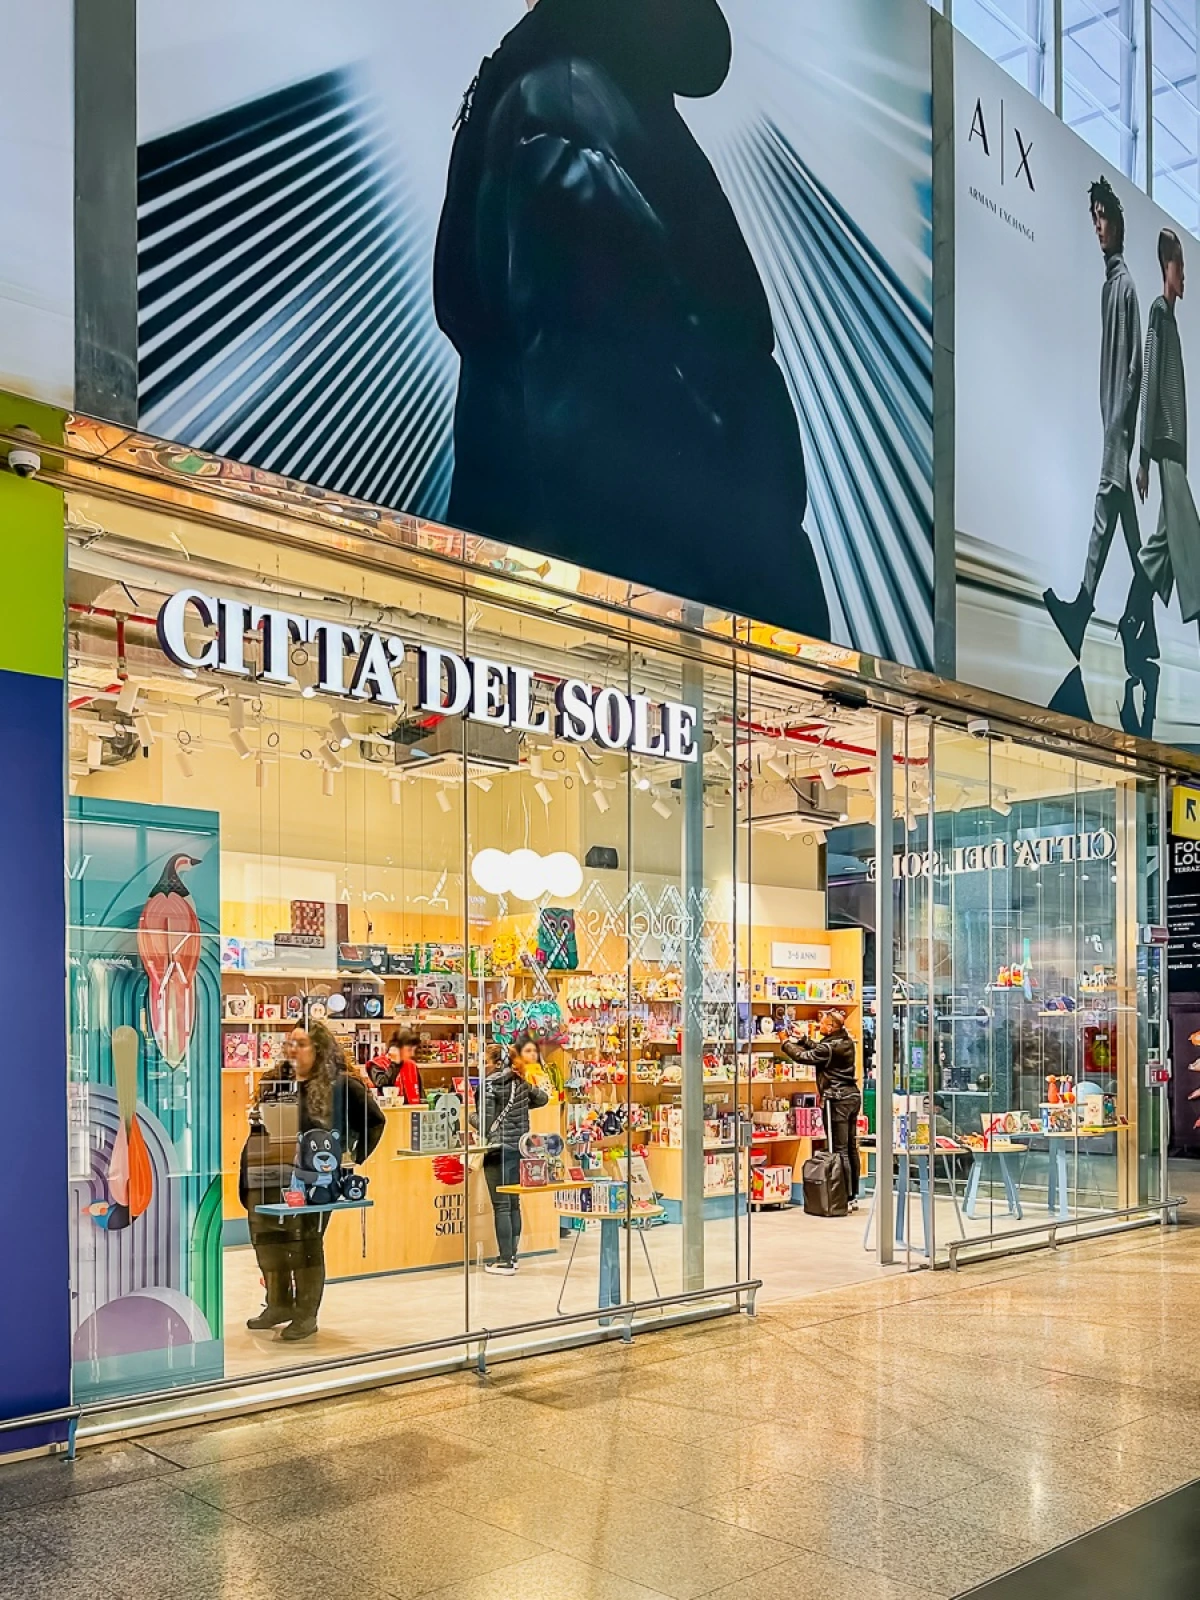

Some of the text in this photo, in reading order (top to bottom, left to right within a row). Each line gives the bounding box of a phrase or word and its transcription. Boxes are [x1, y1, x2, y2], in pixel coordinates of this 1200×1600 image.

[968, 186, 1035, 243] ARMANI EXCHANGE
[411, 645, 552, 735] DEL
[555, 677, 700, 762] SOLE
[439, 1207, 465, 1222] DEL
